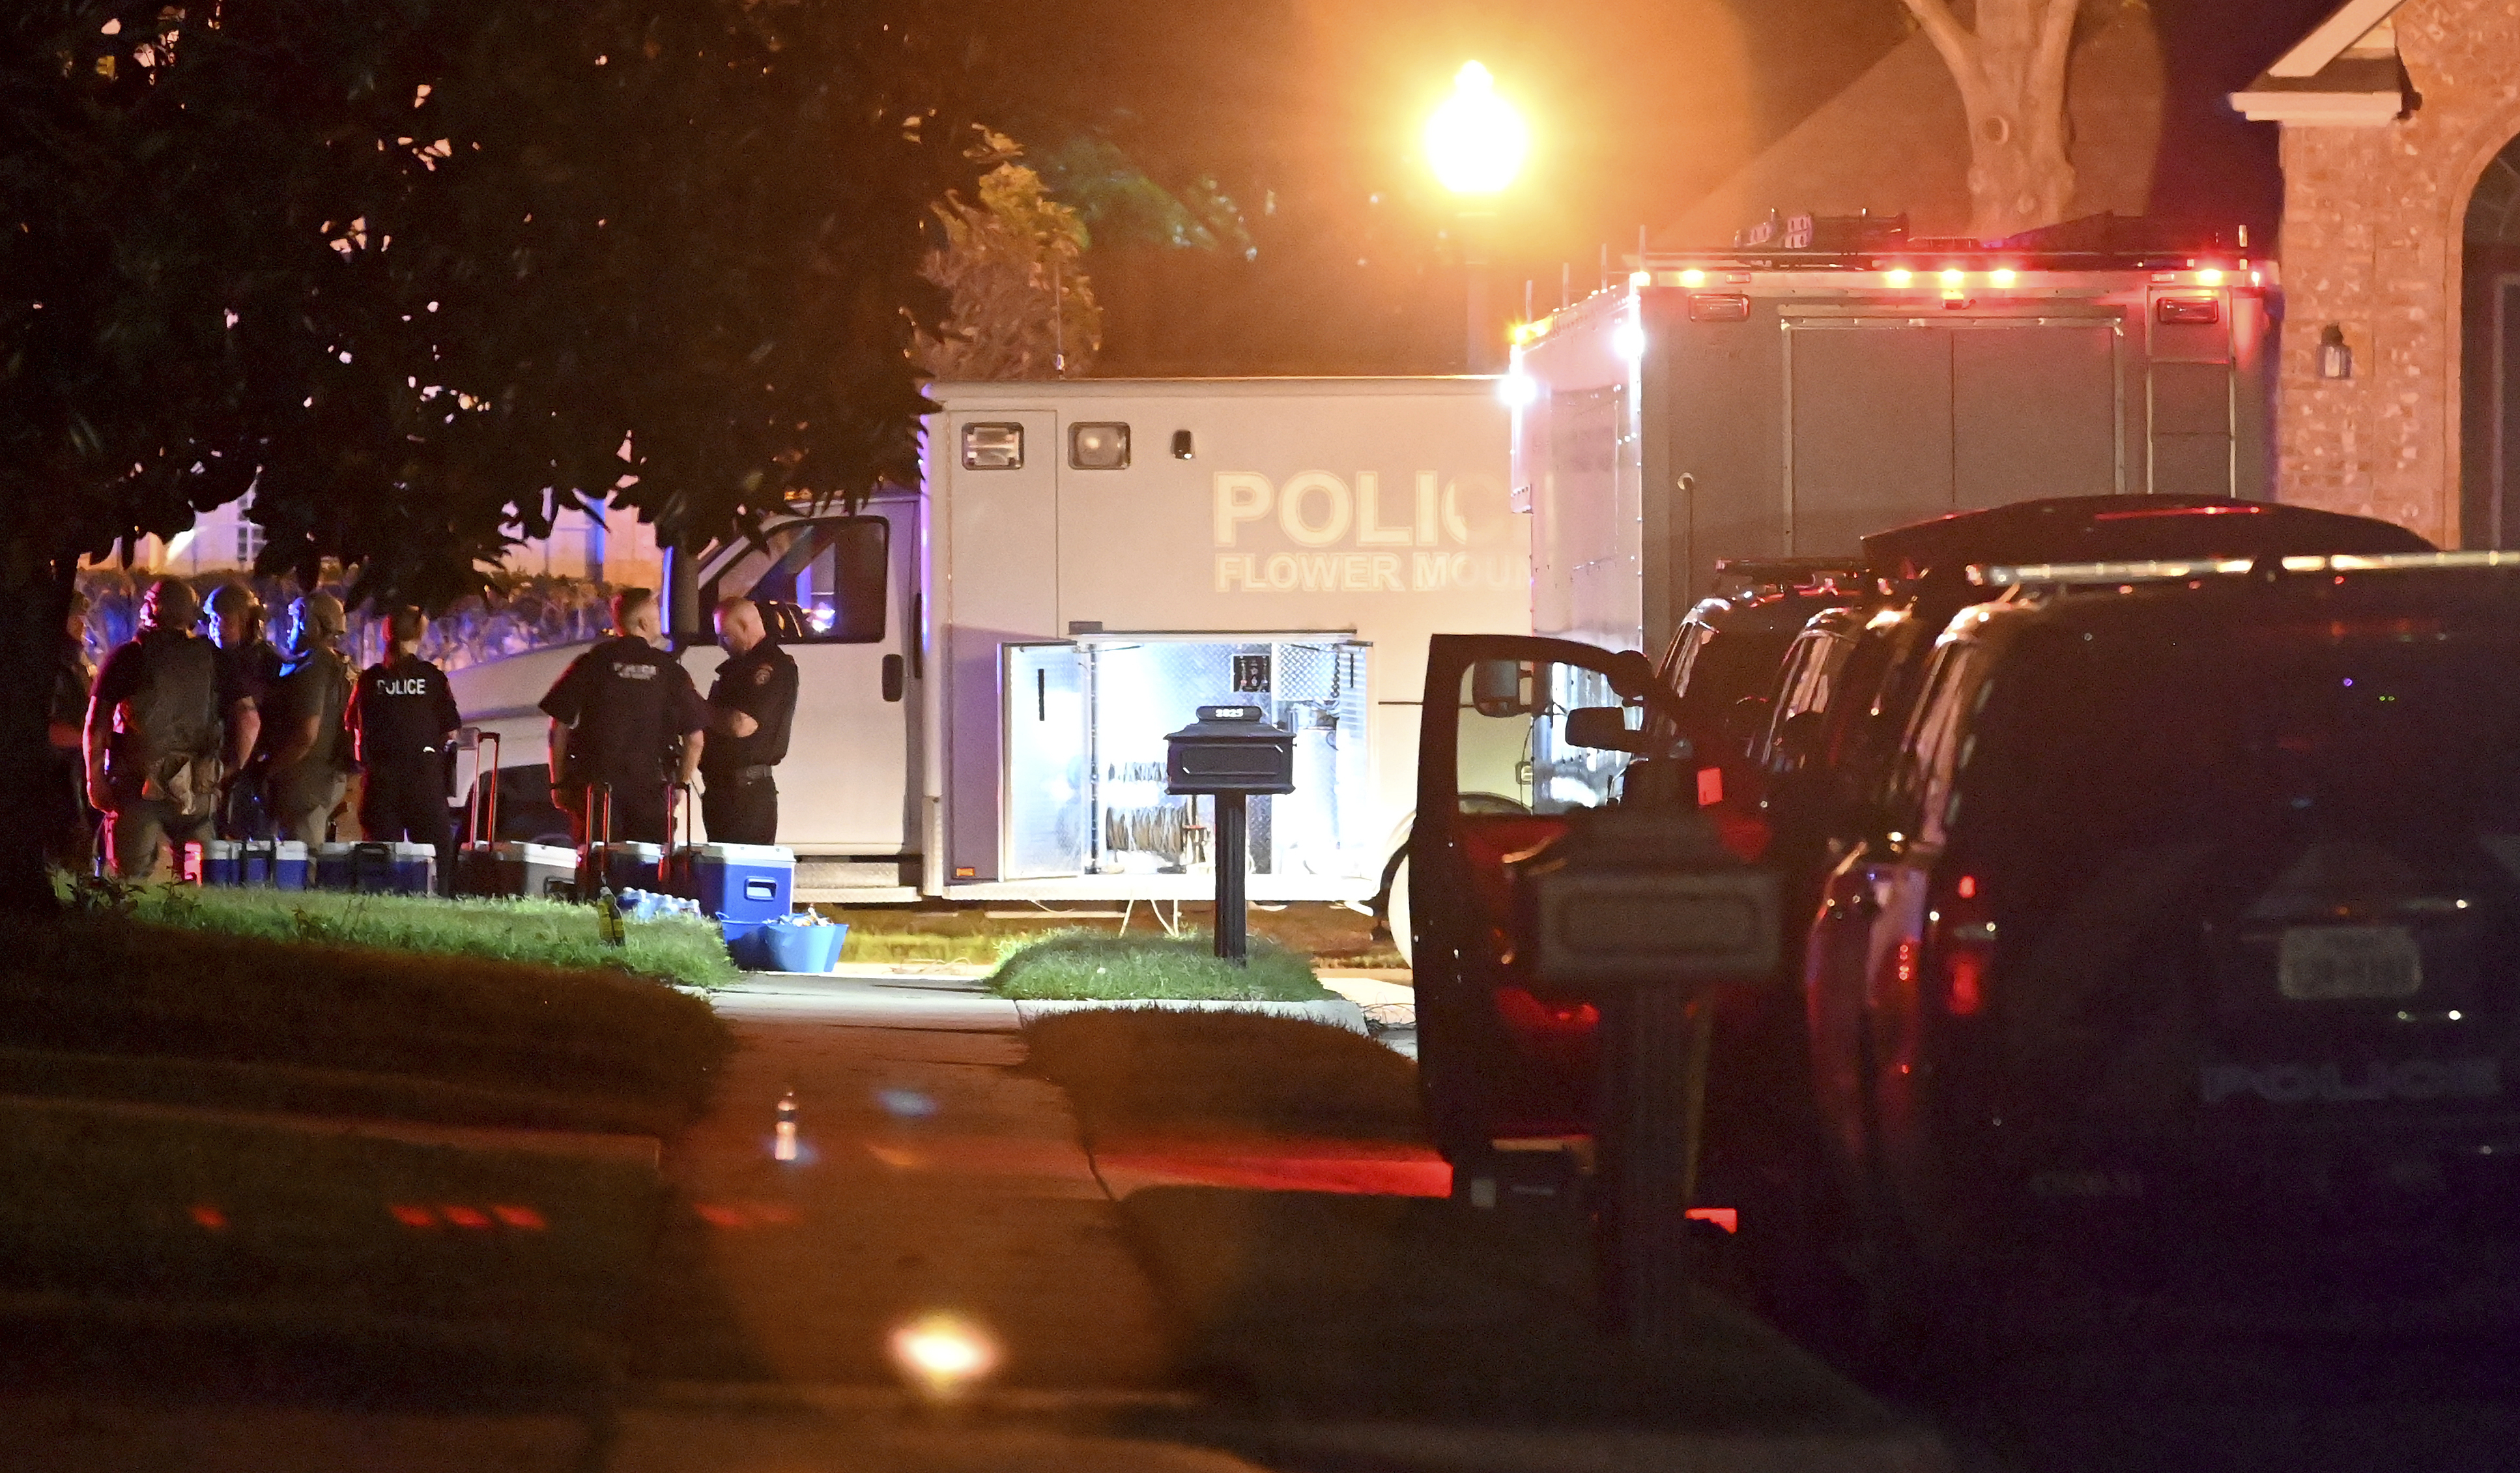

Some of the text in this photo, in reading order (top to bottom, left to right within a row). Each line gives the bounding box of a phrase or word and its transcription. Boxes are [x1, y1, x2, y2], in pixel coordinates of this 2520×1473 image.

[1213, 470, 1525, 548] POLIC
[1214, 552, 1405, 593] FLOWER
[376, 678, 426, 695] POLICE
